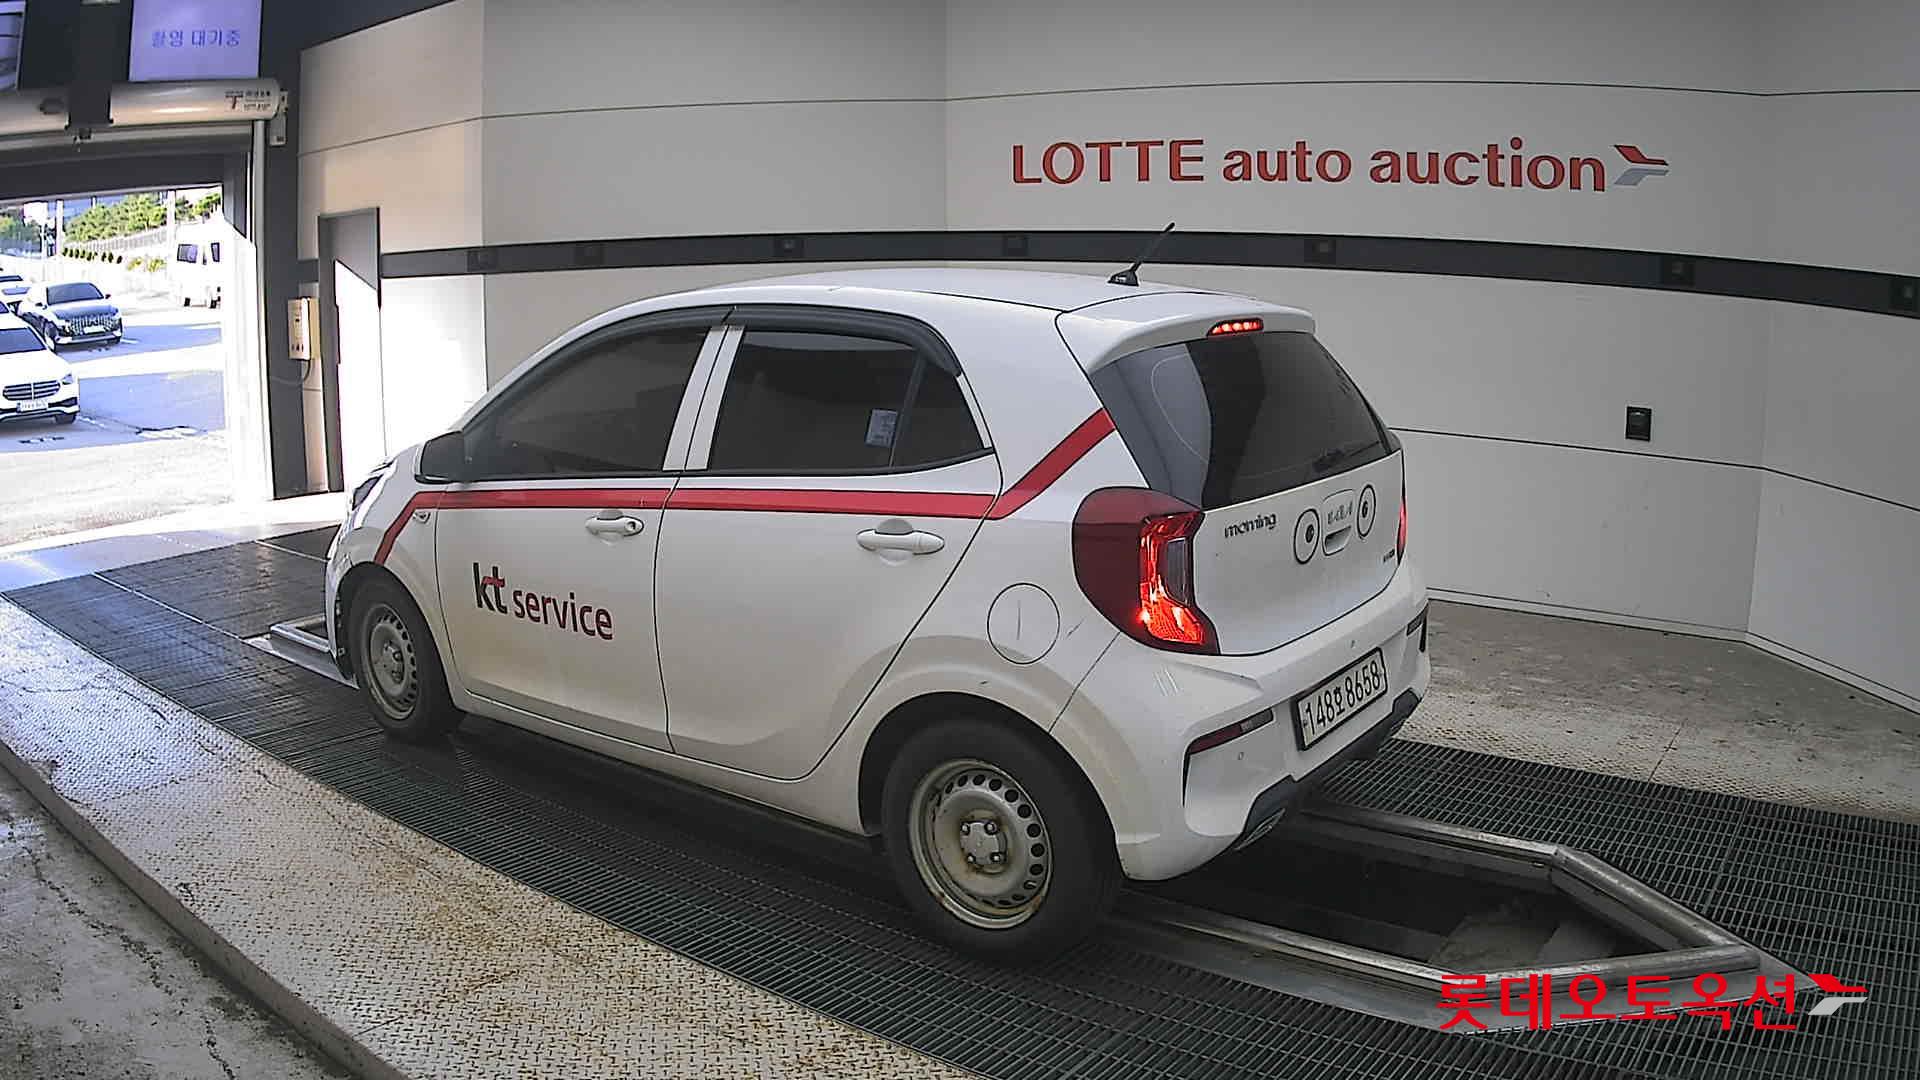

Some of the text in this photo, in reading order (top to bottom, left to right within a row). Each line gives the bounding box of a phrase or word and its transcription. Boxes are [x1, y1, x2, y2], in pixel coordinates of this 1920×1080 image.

[191, 29, 240, 47] 대기중
[1012, 136, 1606, 192] LOTTE auto auction
[1224, 513, 1277, 538] morning
[472, 562, 613, 641] kt service
[1305, 660, 1381, 736] 148호8658
